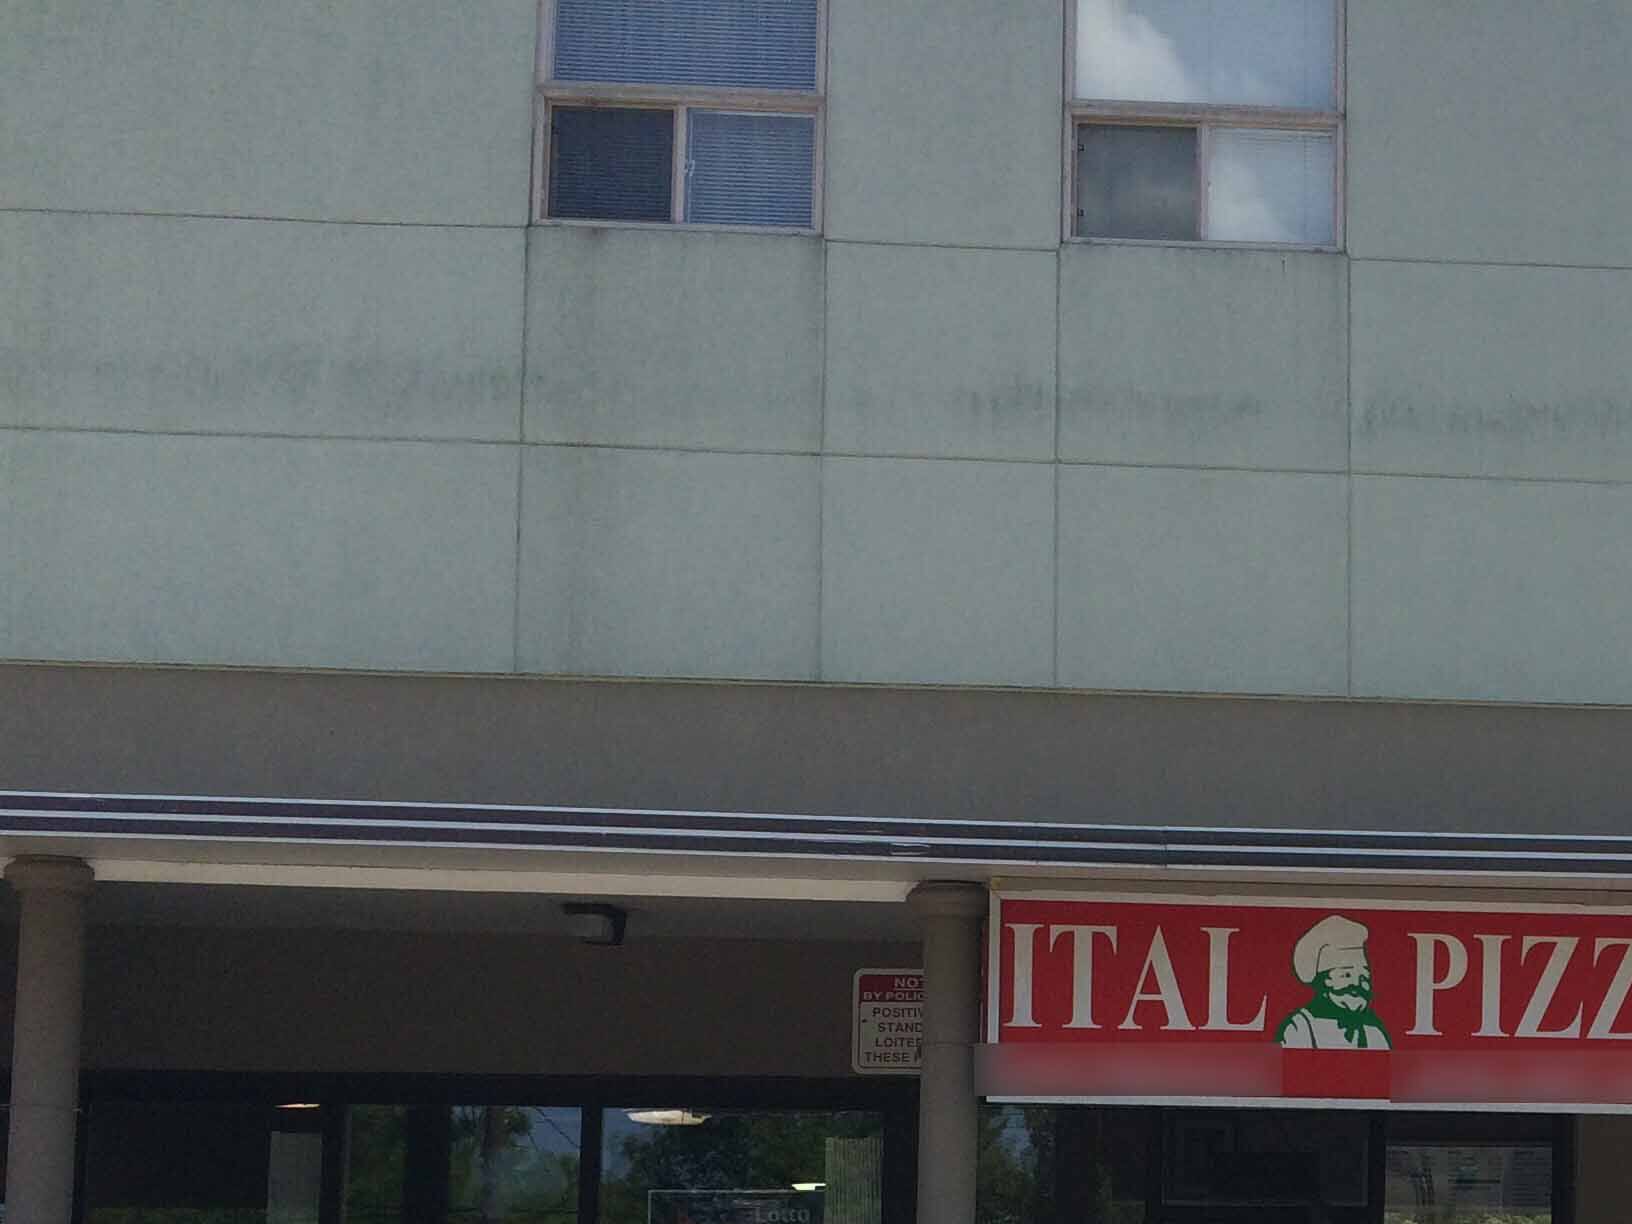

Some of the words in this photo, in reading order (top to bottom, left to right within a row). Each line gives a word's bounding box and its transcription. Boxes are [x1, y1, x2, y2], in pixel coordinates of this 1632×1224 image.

[1003, 921, 1268, 1033] ITAL
[863, 991, 881, 1001] BY
[864, 1052, 910, 1063] THESE
[754, 1206, 811, 1223] Lotto
